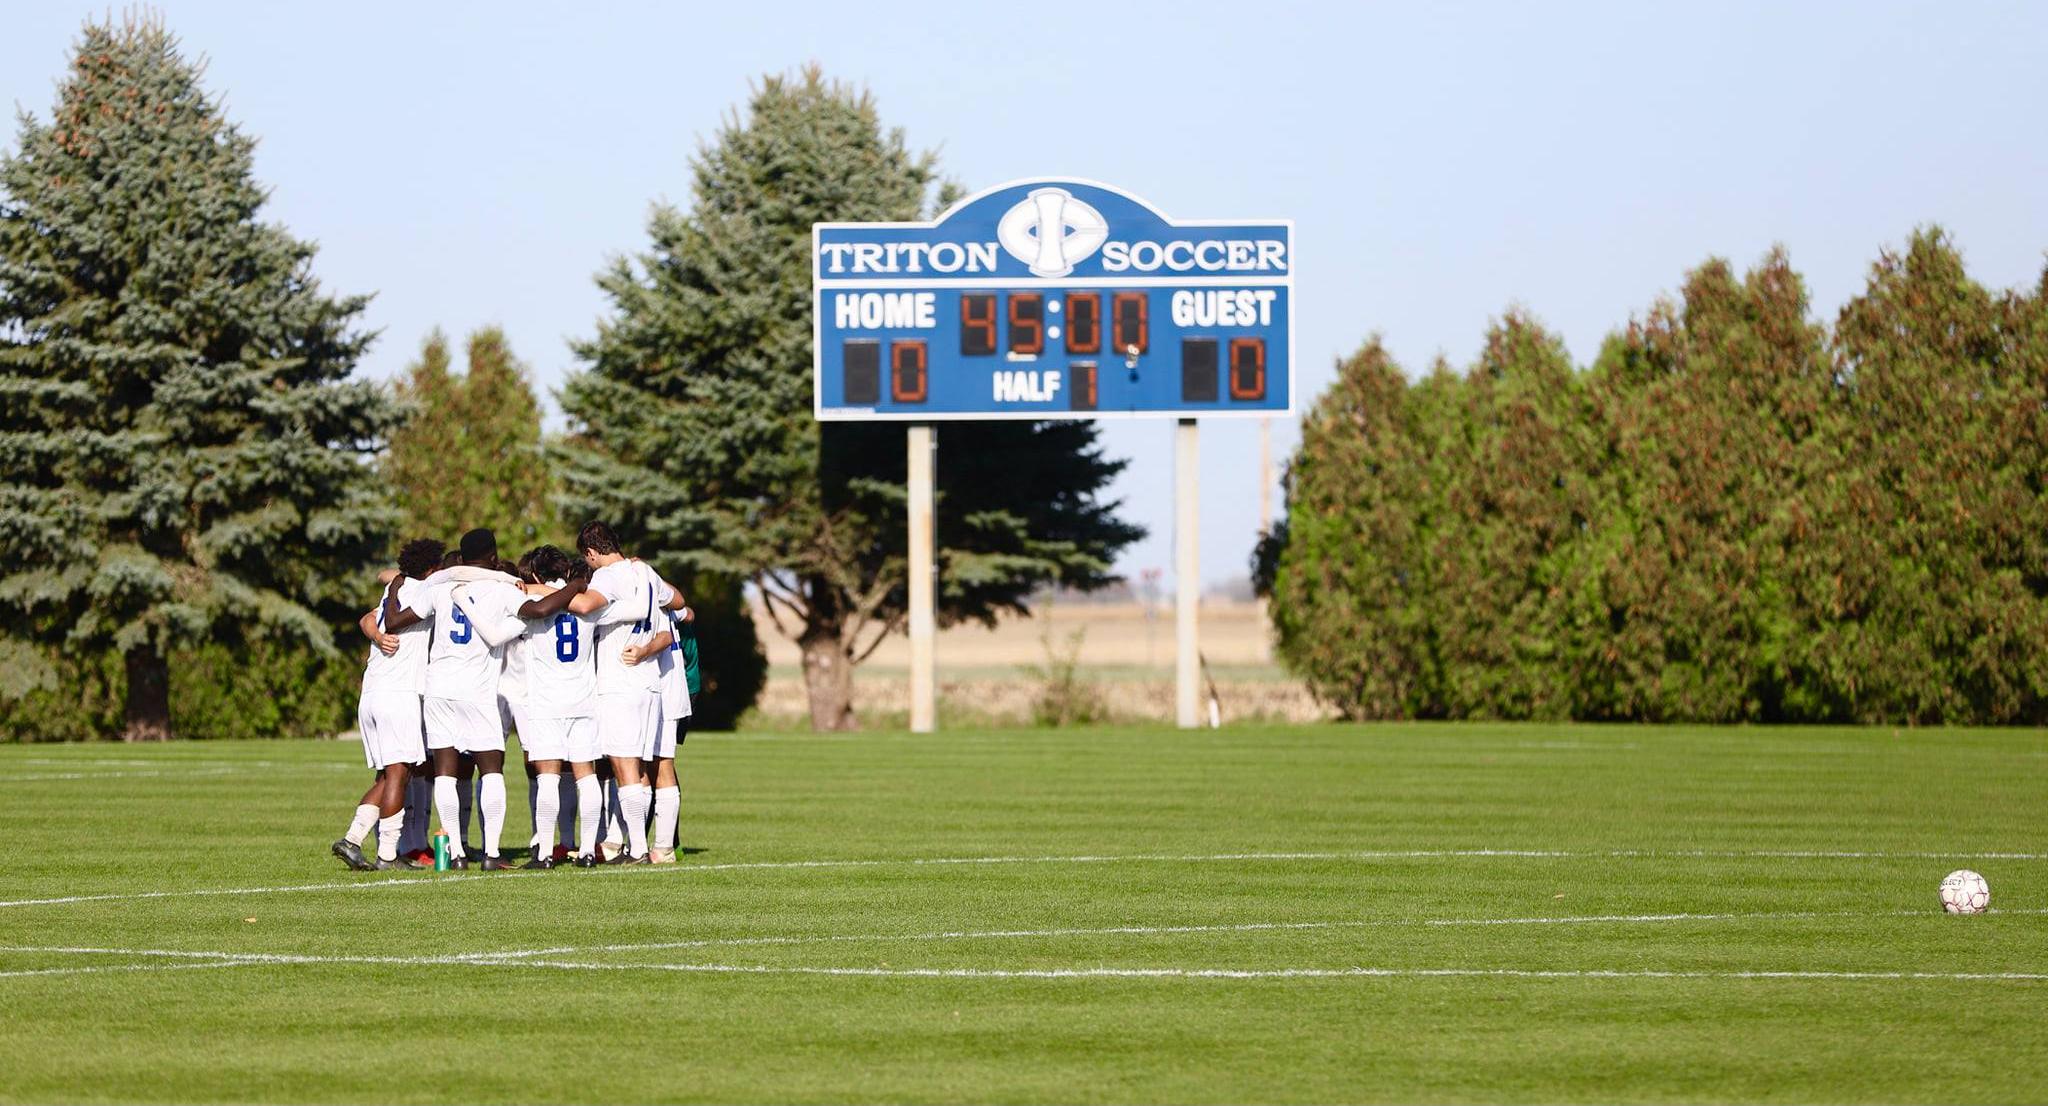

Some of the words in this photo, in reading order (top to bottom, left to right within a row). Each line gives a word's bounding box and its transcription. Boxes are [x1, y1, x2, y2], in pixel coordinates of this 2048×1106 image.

[820, 241, 1000, 273] TRITON
[1102, 240, 1288, 272] SOCCER
[835, 292, 936, 329] HOME
[962, 293, 1147, 353] 45:00
[1171, 290, 1277, 327] GUEST
[891, 341, 927, 402] 0
[993, 370, 1061, 402] HALF
[1230, 339, 1265, 400] 0
[555, 613, 579, 662] 8
